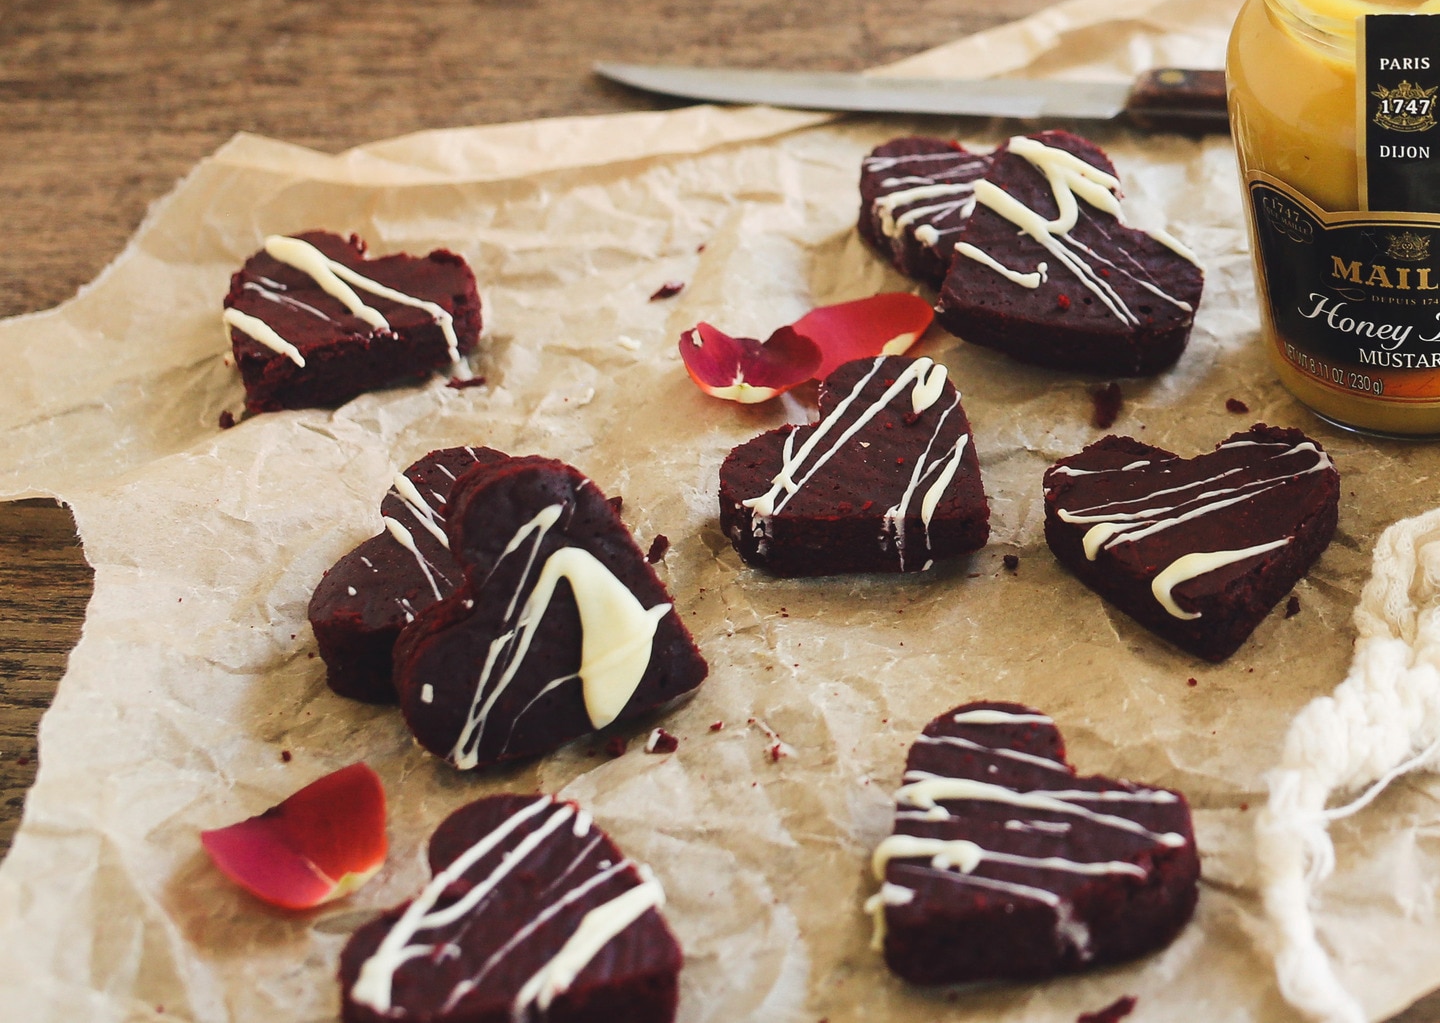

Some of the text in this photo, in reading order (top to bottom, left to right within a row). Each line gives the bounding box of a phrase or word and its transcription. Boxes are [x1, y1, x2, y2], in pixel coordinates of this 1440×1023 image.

[1379, 57, 1431, 70] PARIS
[1381, 99, 1431, 115] 1747
[1379, 145, 1431, 159] DIJON
[1371, 295, 1418, 306] DEPUIS
[1297, 292, 1414, 350] Honey
[1309, 358, 1329, 379] 8.11
[1331, 367, 1345, 385] OZ
[1347, 372, 1371, 391] (230
[1372, 378, 1383, 395] g)
